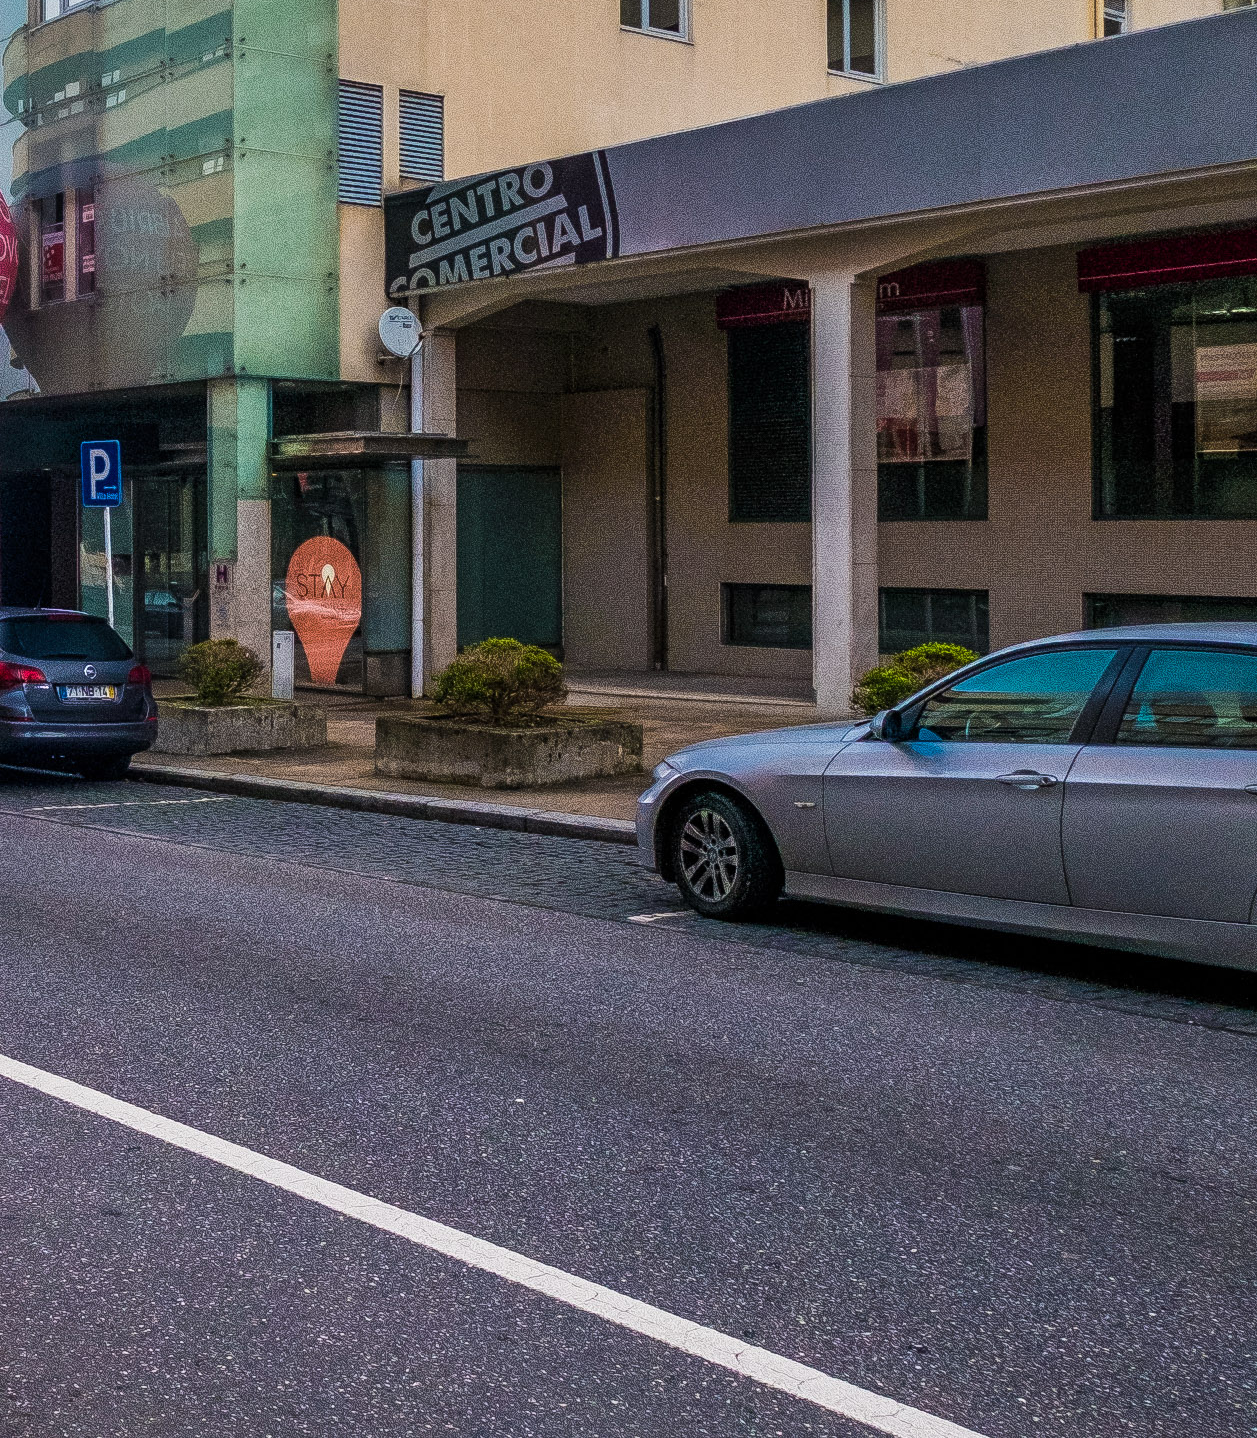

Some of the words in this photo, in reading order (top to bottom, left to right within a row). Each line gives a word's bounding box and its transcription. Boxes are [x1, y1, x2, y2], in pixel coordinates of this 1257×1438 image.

[410, 162, 554, 245] CENTRO
[89, 448, 111, 500] P
[216, 564, 227, 583] H
[296, 573, 350, 599] STAY
